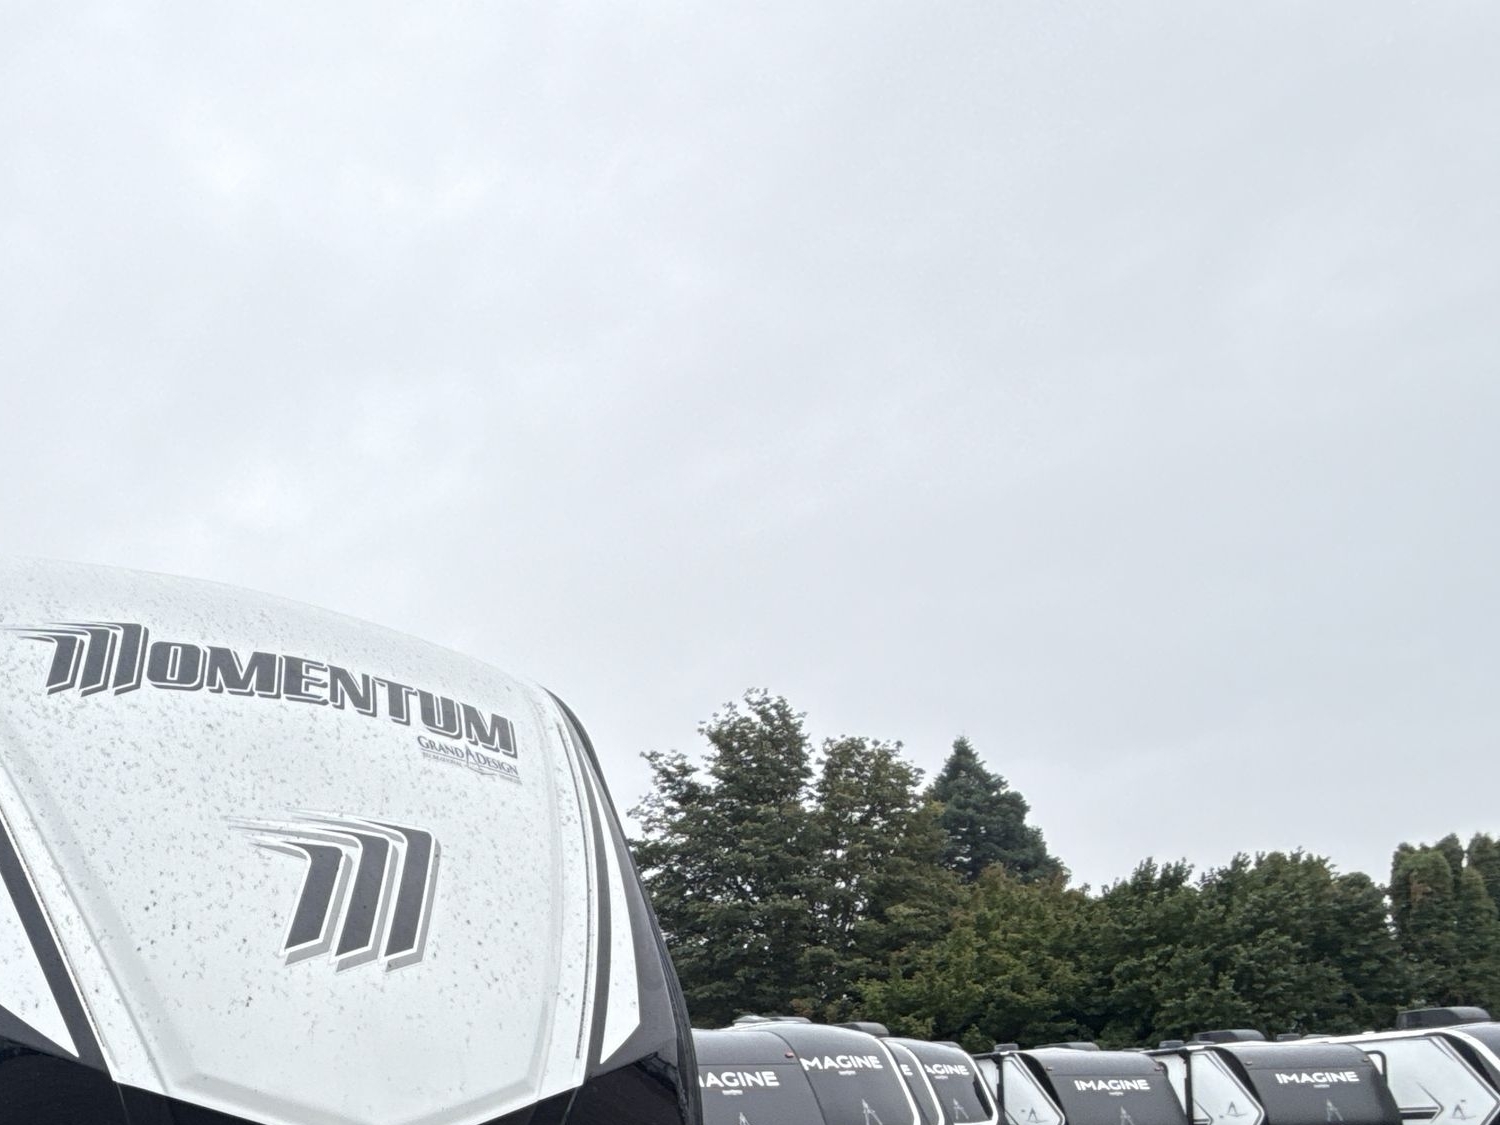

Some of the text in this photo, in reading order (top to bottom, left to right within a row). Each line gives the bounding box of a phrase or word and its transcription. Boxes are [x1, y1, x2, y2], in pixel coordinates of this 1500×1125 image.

[1, 621, 518, 759] MOMENTUM
[417, 735, 465, 759] GRAND
[474, 751, 519, 776] DESIGN
[799, 1055, 883, 1071] MAGINE
[698, 1071, 780, 1088] AGINE
[1074, 1079, 1151, 1092] IMAGINE
[1274, 1071, 1360, 1085] IMAGINE
